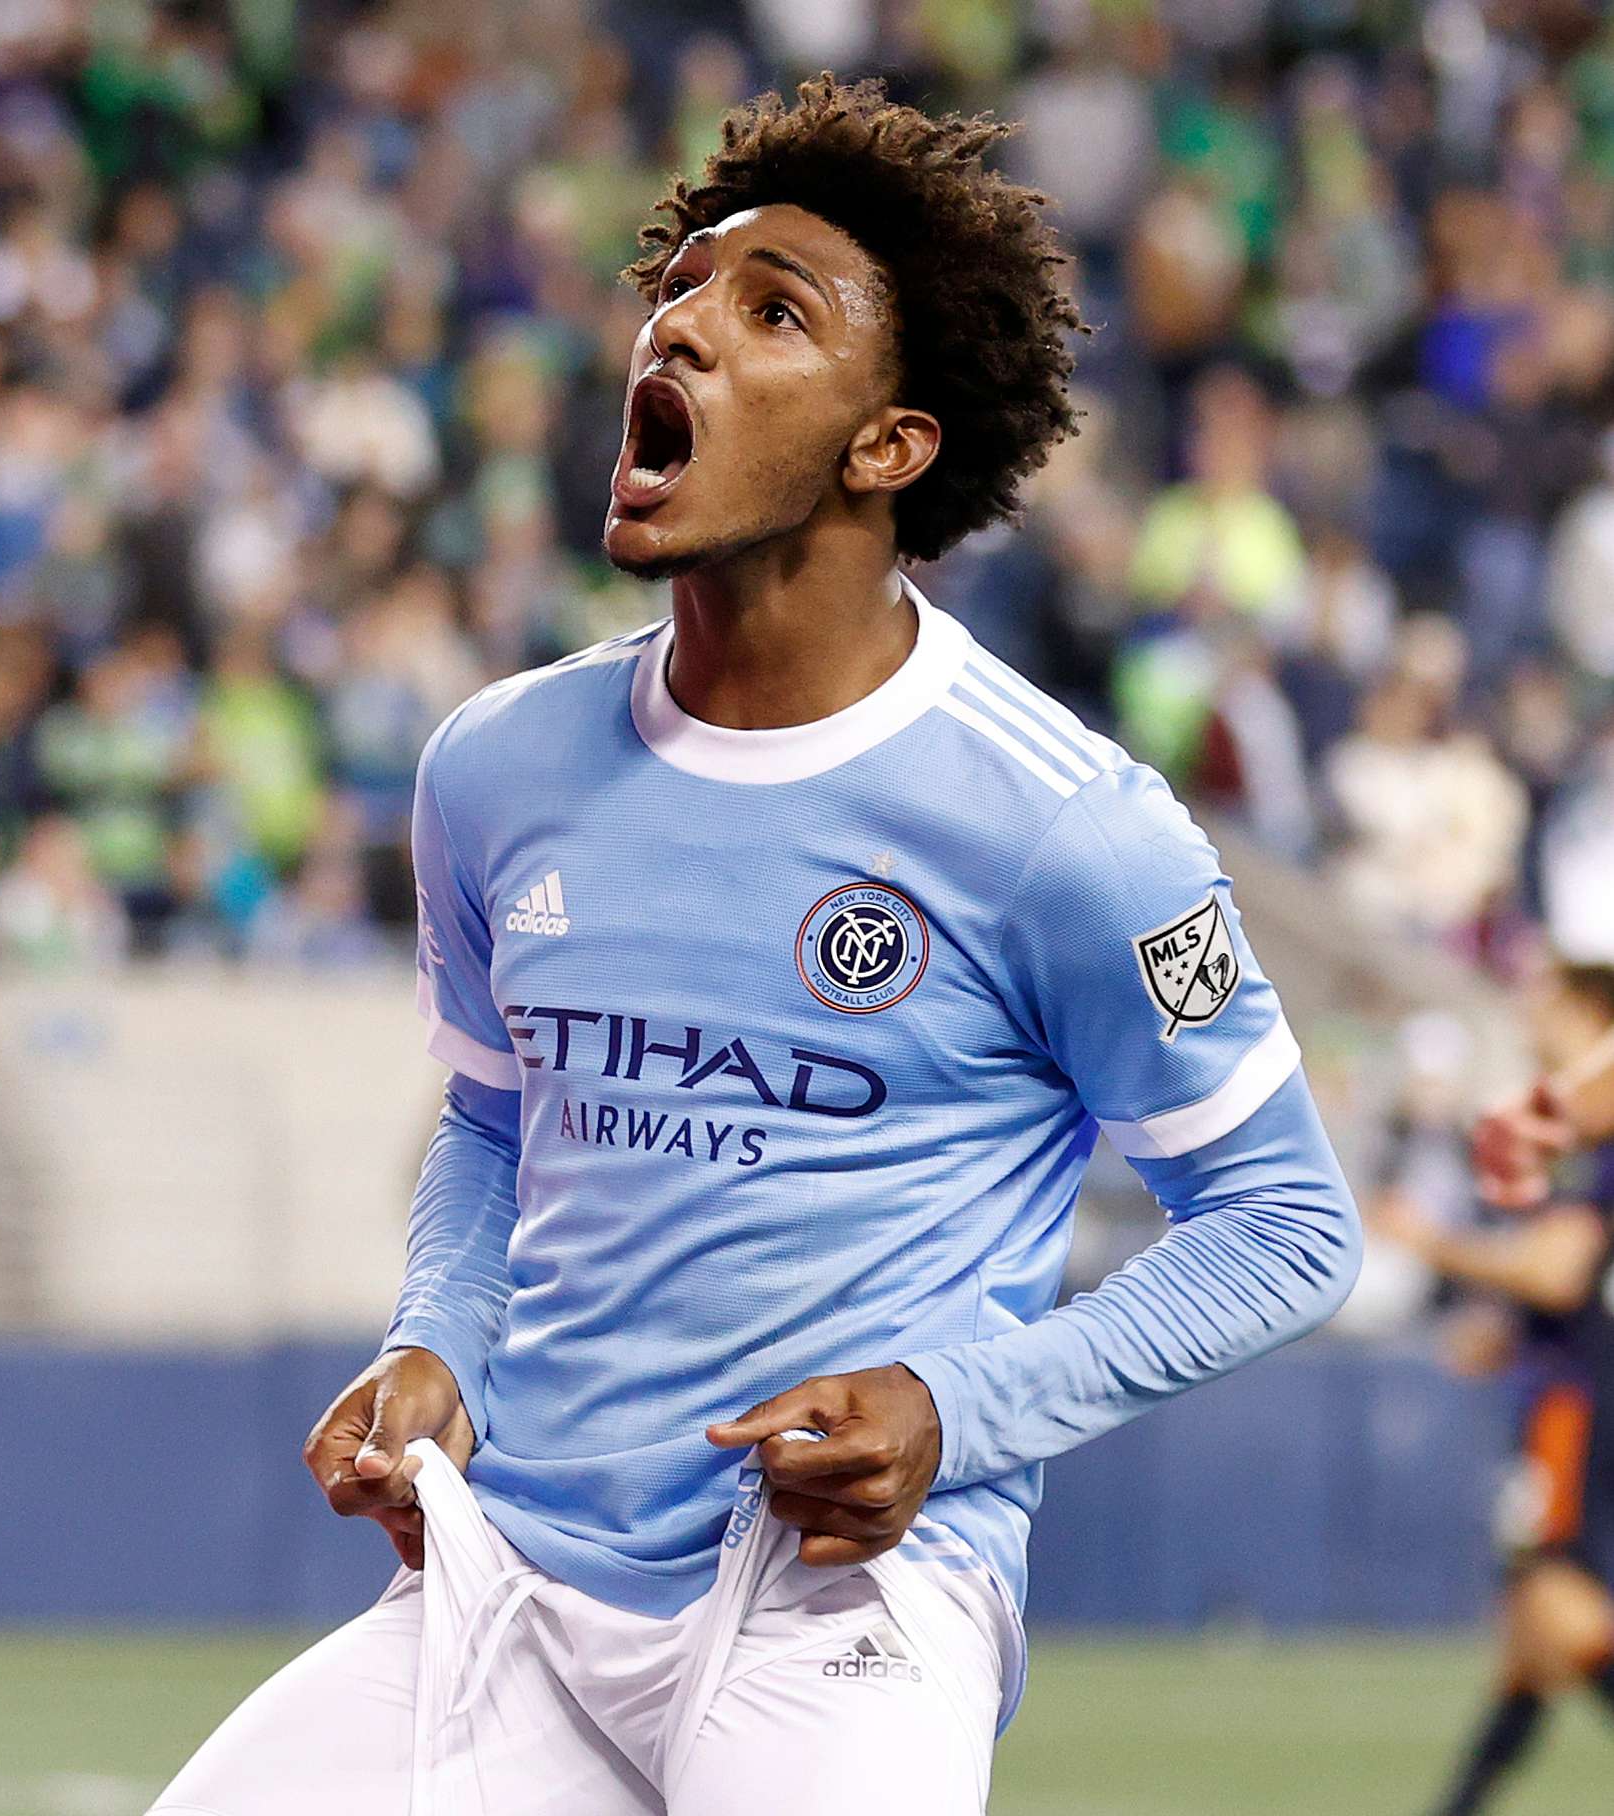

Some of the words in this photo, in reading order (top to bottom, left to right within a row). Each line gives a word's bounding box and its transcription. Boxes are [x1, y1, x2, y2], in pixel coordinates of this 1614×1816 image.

[505, 908, 571, 936] adidas
[829, 892, 856, 910] NEW
[860, 891, 892, 905] YORK
[891, 901, 913, 922] CITY
[1149, 925, 1202, 968] MLS
[812, 972, 863, 1005] FOOTBALL
[865, 986, 897, 1004] CLUB
[504, 1005, 887, 1118] ETIHAD
[560, 1099, 767, 1166] AIRWAYS
[822, 1655, 923, 1683] adidas
